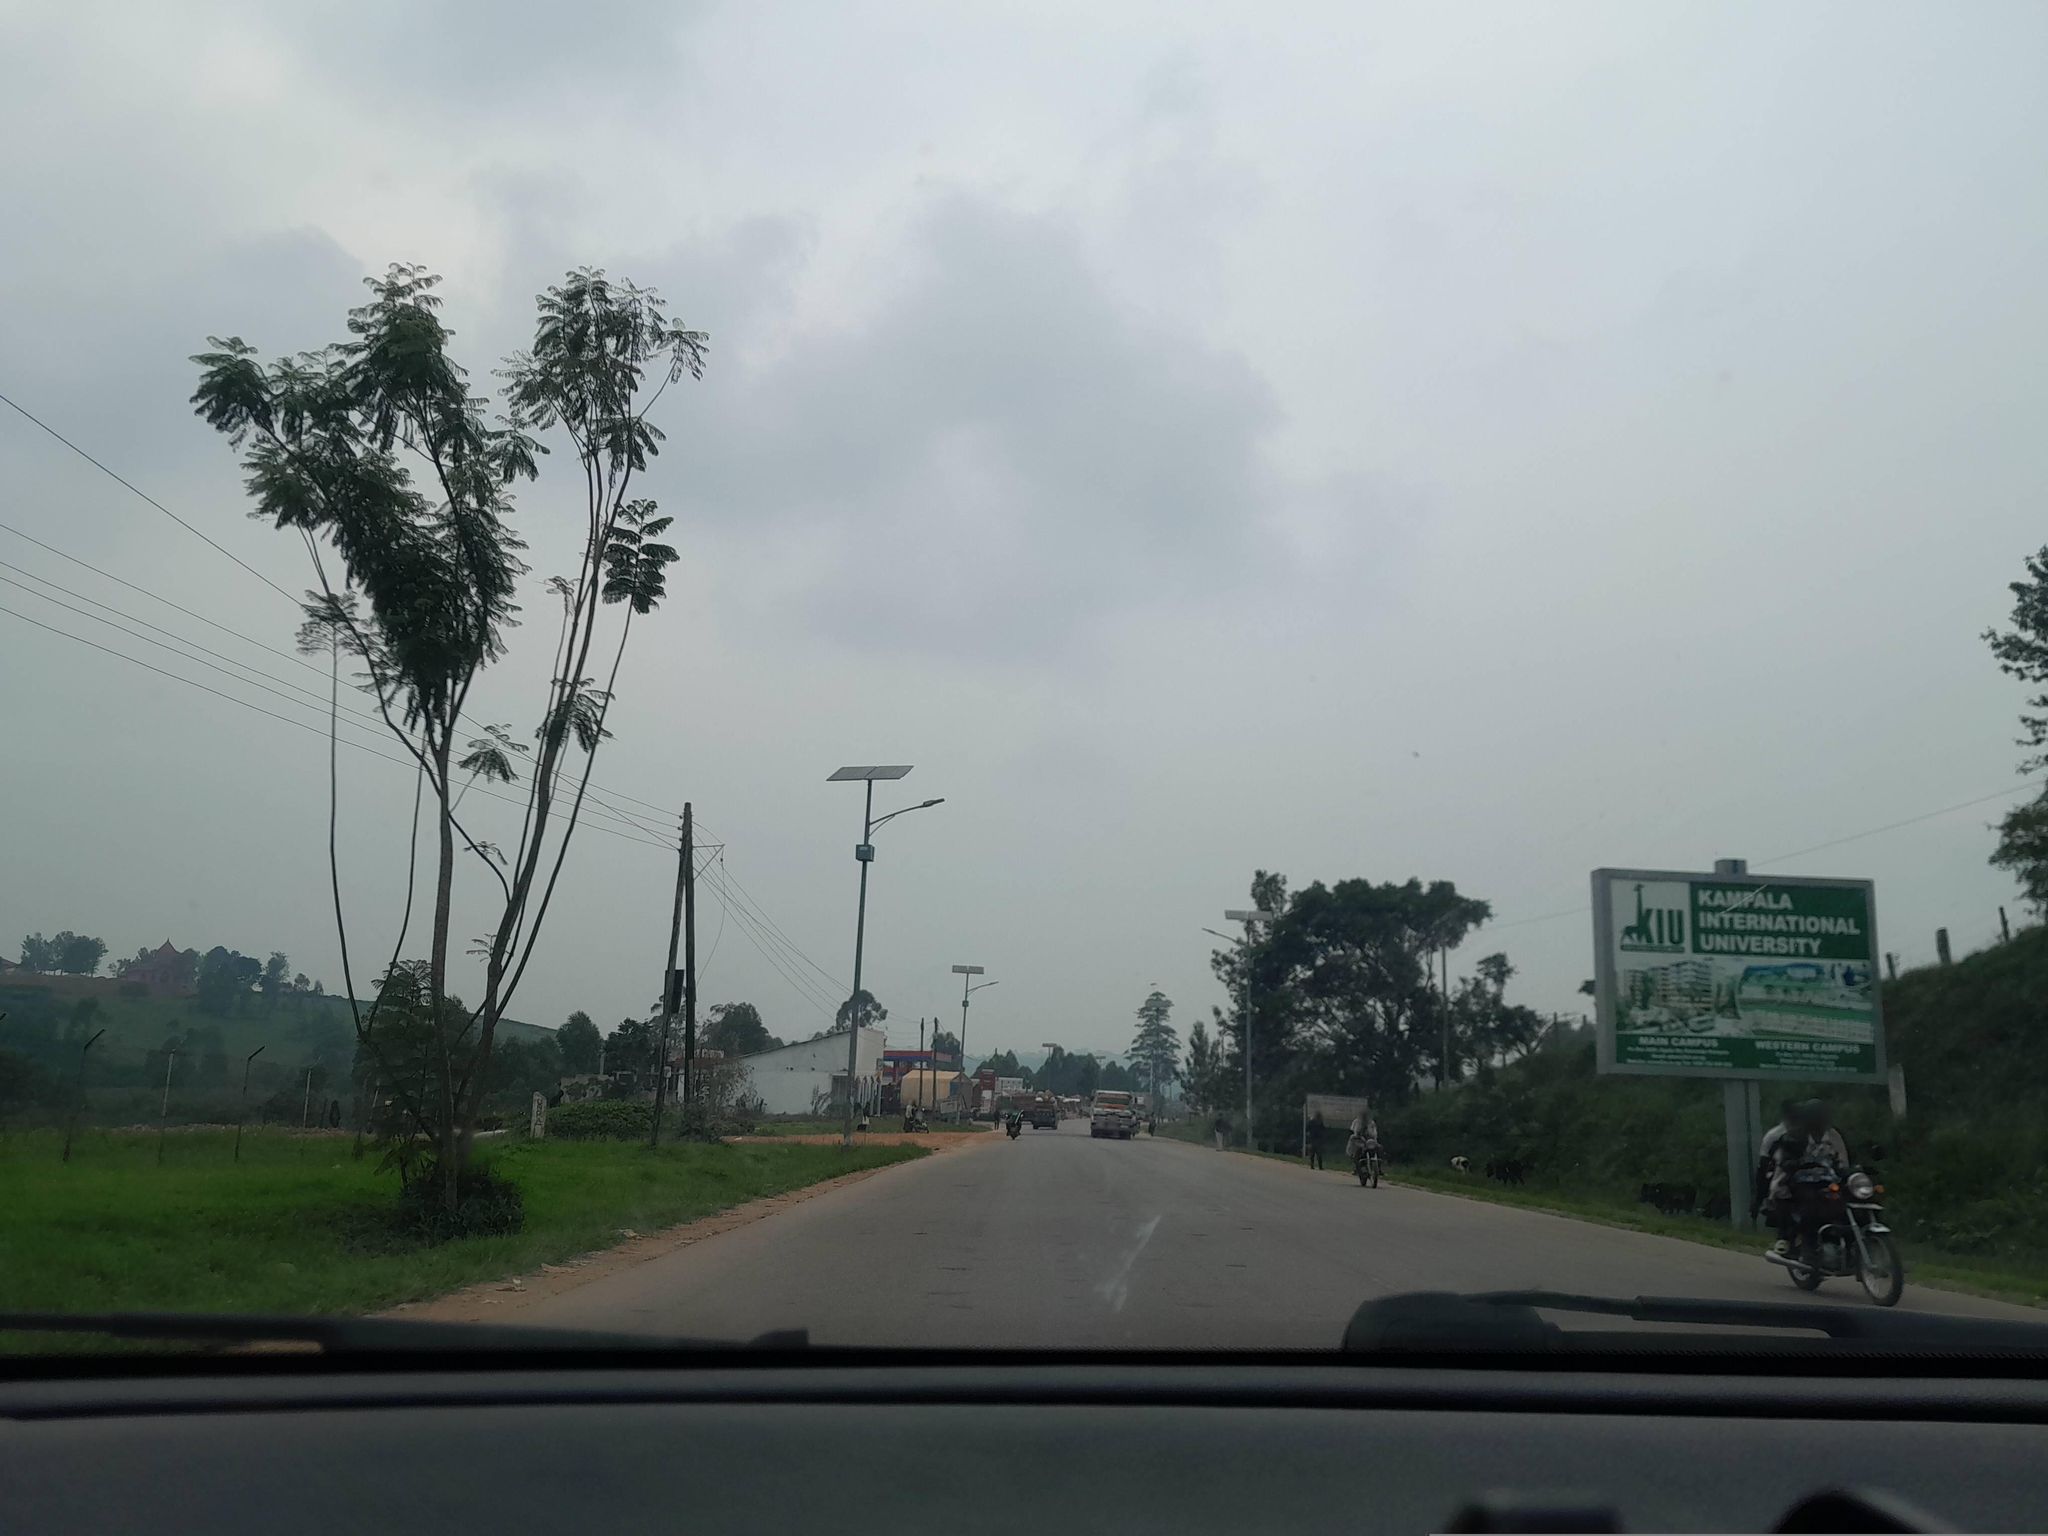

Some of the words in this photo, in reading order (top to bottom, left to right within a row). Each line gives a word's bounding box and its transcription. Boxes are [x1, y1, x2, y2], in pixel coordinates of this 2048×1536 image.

[1697, 889, 1793, 910] KAMPALA
[1637, 908, 1683, 944] KIU
[1699, 912, 1861, 935] INTERNATIONAL
[1700, 933, 1822, 954] UNIVERSITY
[1638, 1036, 1669, 1046] MAIN
[1670, 1037, 1719, 1048] CAMPUS
[1754, 1040, 1810, 1051] WESTERN
[1812, 1042, 1861, 1054] CAMPUS
